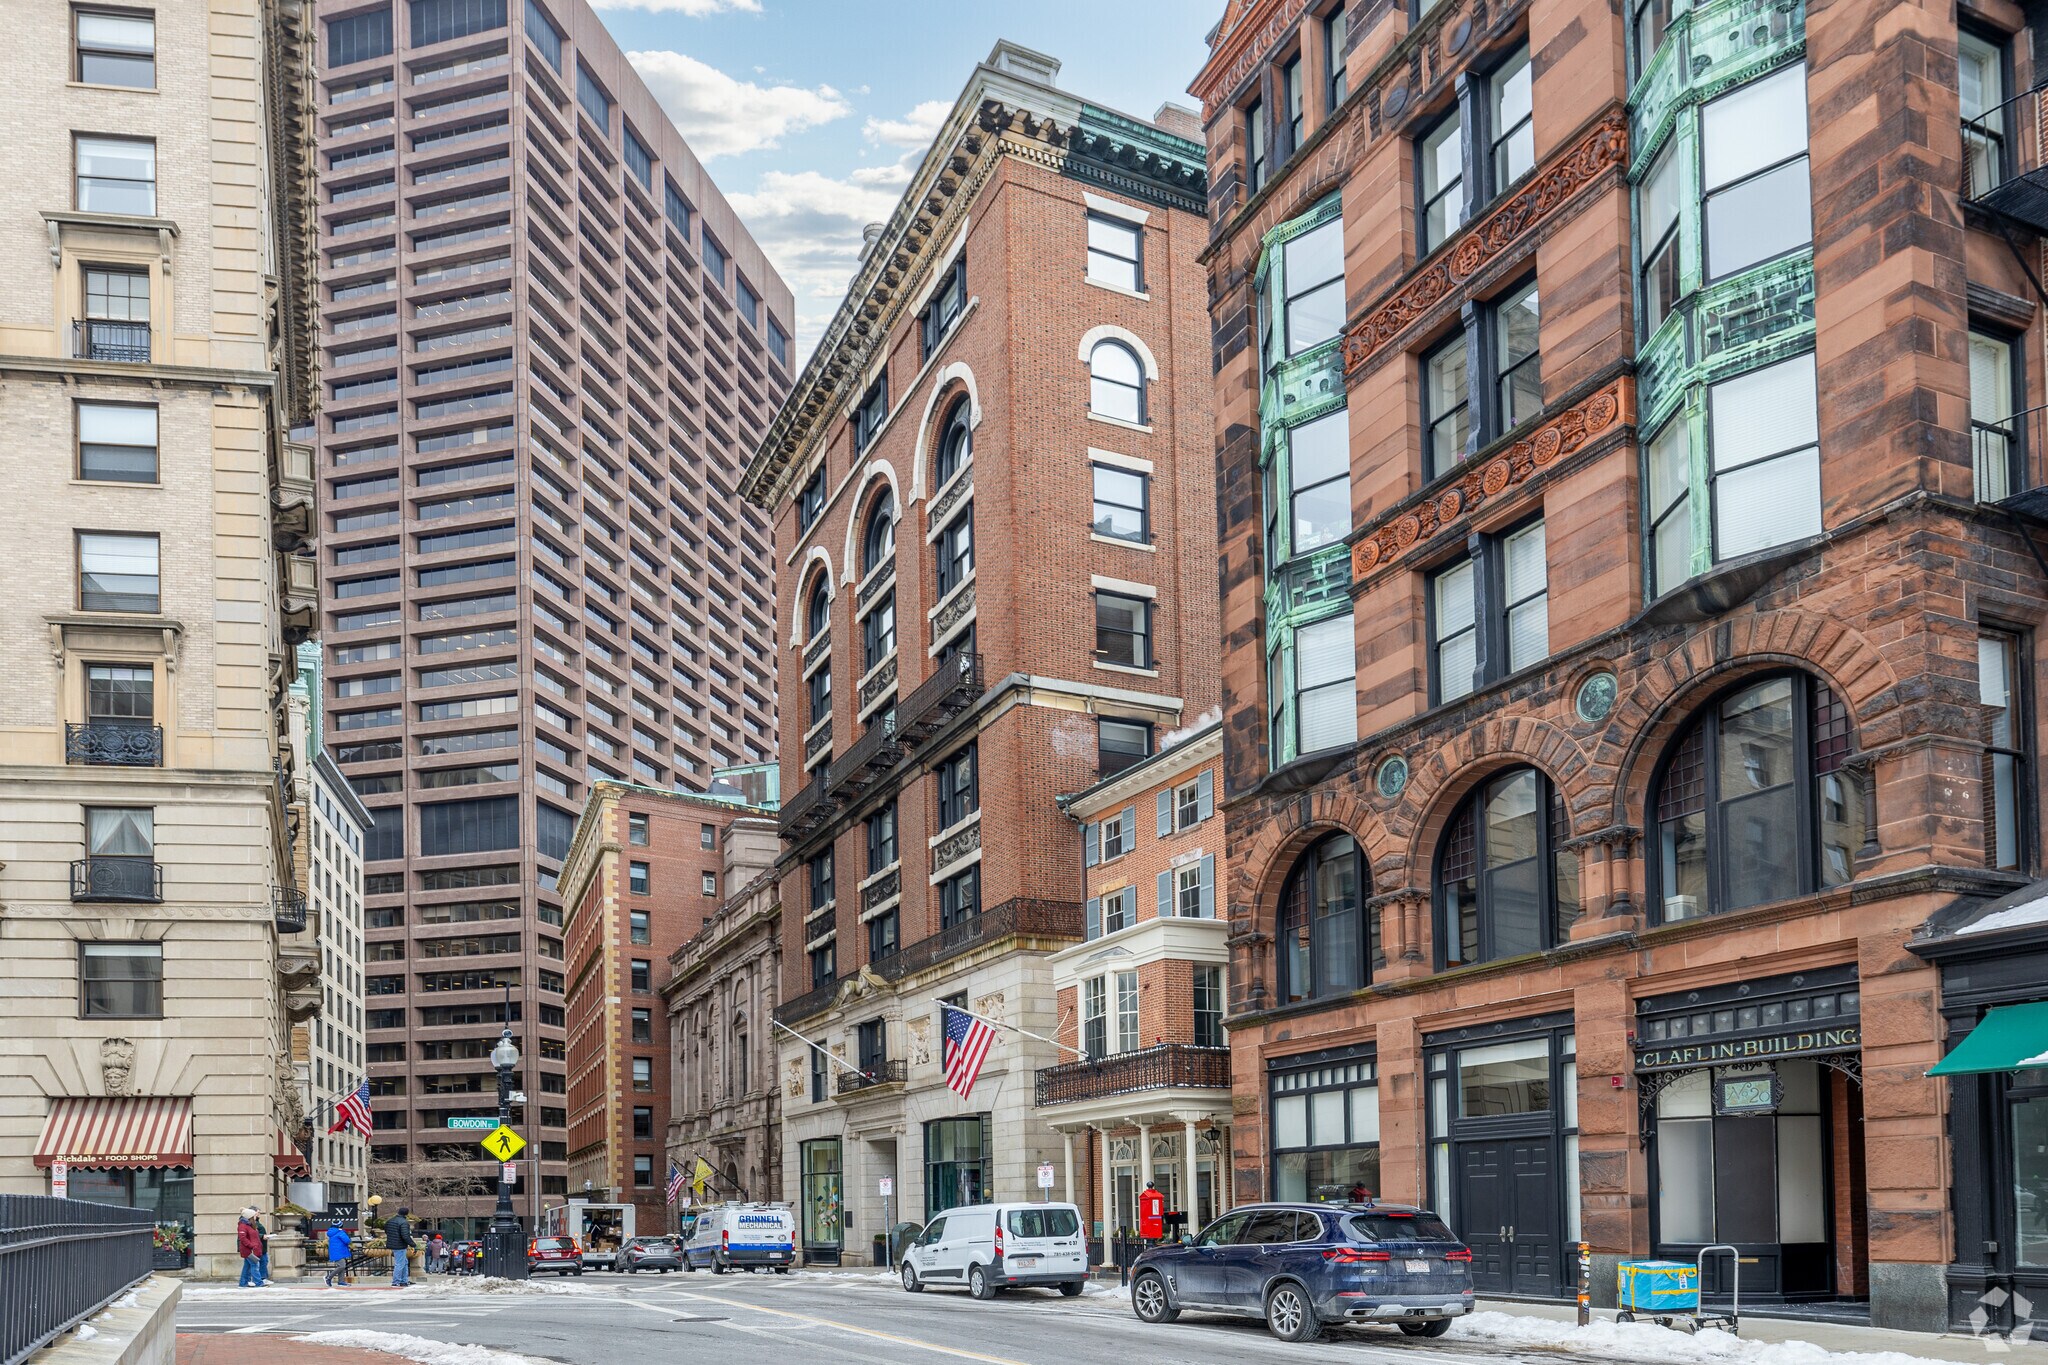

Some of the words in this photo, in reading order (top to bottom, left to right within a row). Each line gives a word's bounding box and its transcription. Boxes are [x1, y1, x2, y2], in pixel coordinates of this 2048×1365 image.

[1643, 1043, 1734, 1066] CLAFLIN
[1744, 1029, 1857, 1056] BUILDING
[1750, 1087, 1770, 1103] 20
[453, 1119, 487, 1128] BOWDOIN
[56, 1154, 97, 1163] Richdale
[335, 1207, 353, 1216] XV
[739, 1215, 781, 1223] GRINNELL
